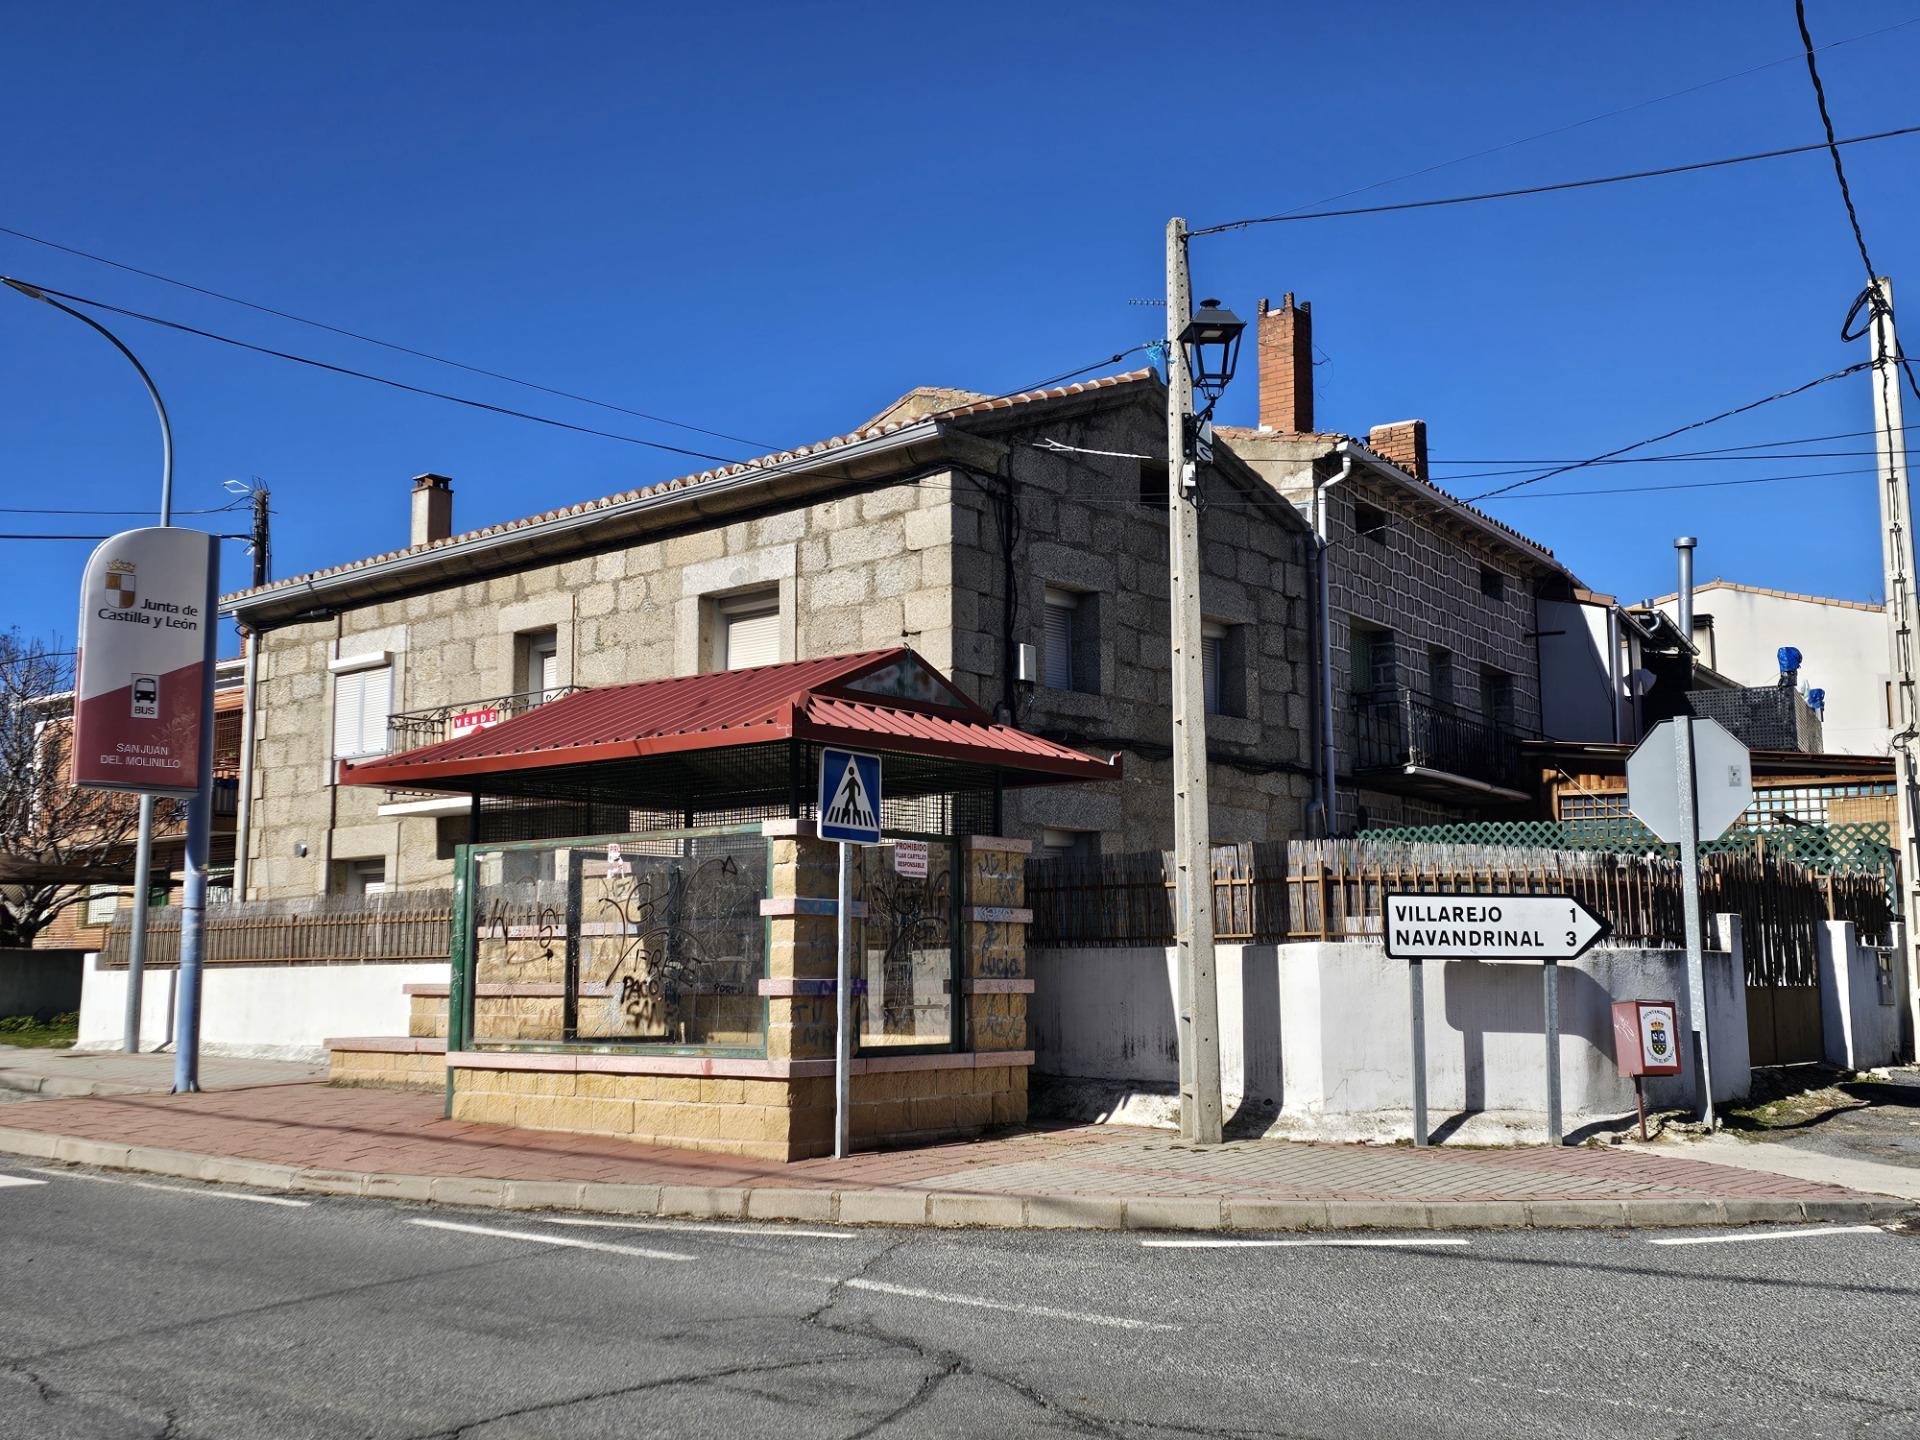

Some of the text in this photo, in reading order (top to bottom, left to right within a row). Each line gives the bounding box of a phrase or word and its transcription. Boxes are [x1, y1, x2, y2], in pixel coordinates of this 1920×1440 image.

[141, 598, 198, 617] Junta de
[98, 608, 196, 630] Castilla y León
[134, 706, 155, 715] BUS
[456, 711, 496, 727] VENDE
[116, 743, 168, 756] SAN JUAN
[100, 754, 181, 769] DEL MOLINILLO
[895, 842, 927, 852] PROHIBIDO
[1396, 906, 1577, 923] VILLAREJO 1
[1396, 930, 1577, 947] NAVANDRINAL 3
[621, 975, 660, 1005] PACO
